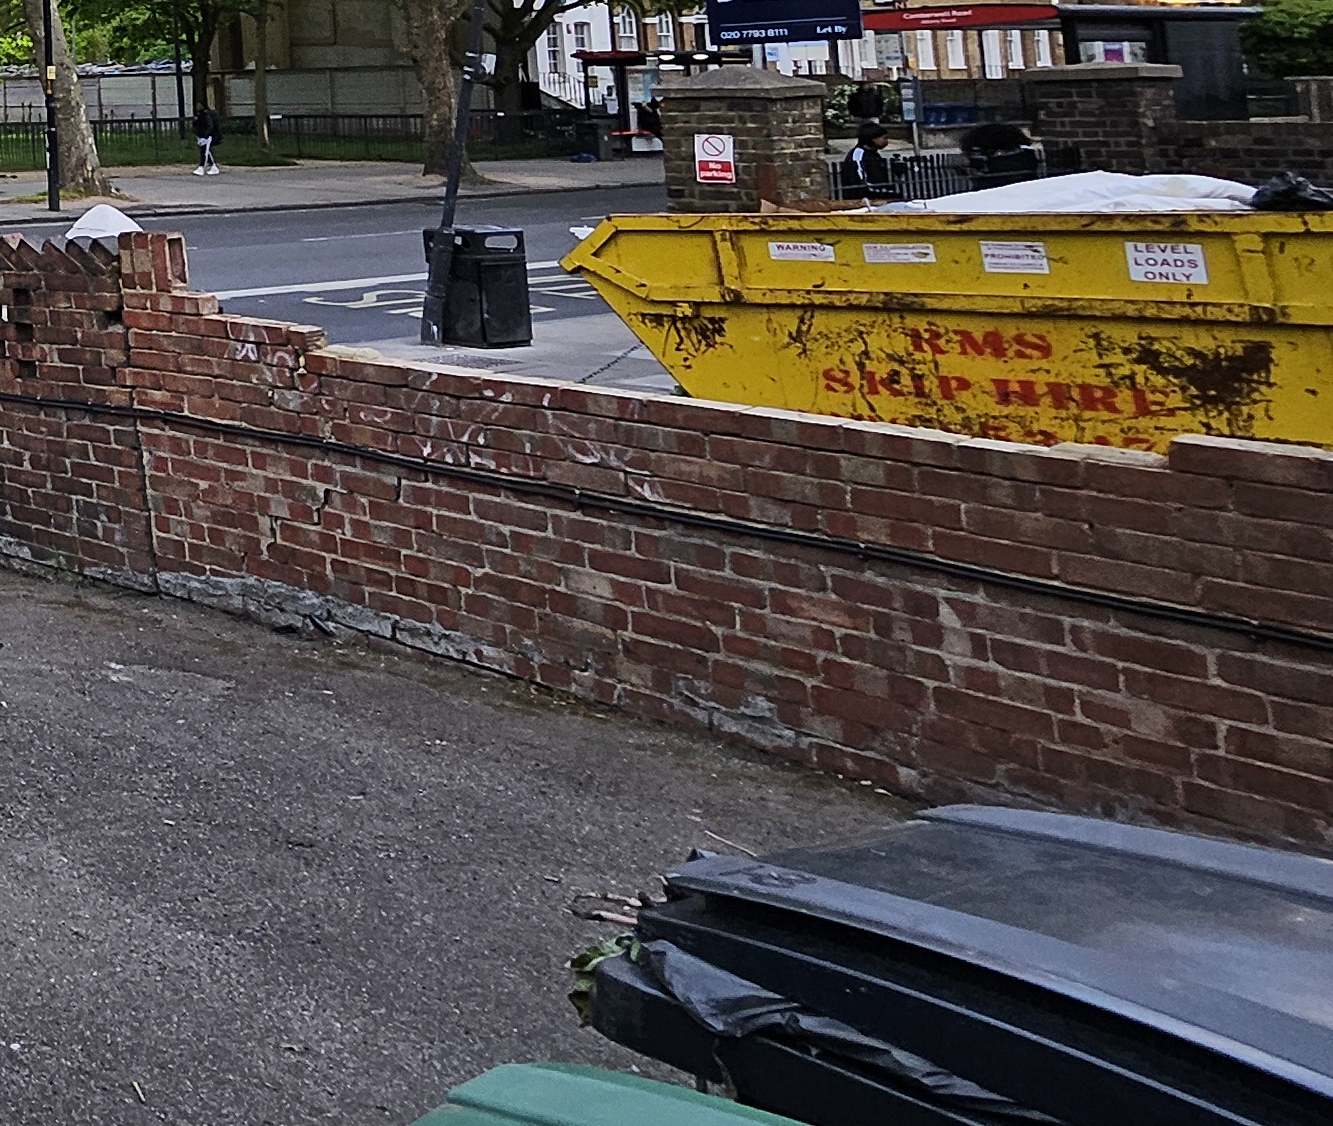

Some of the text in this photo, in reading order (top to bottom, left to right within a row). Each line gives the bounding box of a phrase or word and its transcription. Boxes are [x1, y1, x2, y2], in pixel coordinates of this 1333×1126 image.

[720, 31, 741, 40] 020
[766, 28, 789, 37] 8111
[816, 25, 847, 35] Let By
[708, 161, 723, 170] No
[700, 170, 733, 179] parking
[775, 243, 827, 253] WARNING
[1133, 243, 1195, 255] LEVEL
[983, 252, 1046, 262] PROHIBITED
[1134, 257, 1200, 269] LOADS
[1143, 270, 1194, 282] ONLY
[906, 326, 1053, 360] RMS
[821, 367, 972, 402] SKIP
[990, 377, 1177, 418] HIRE
